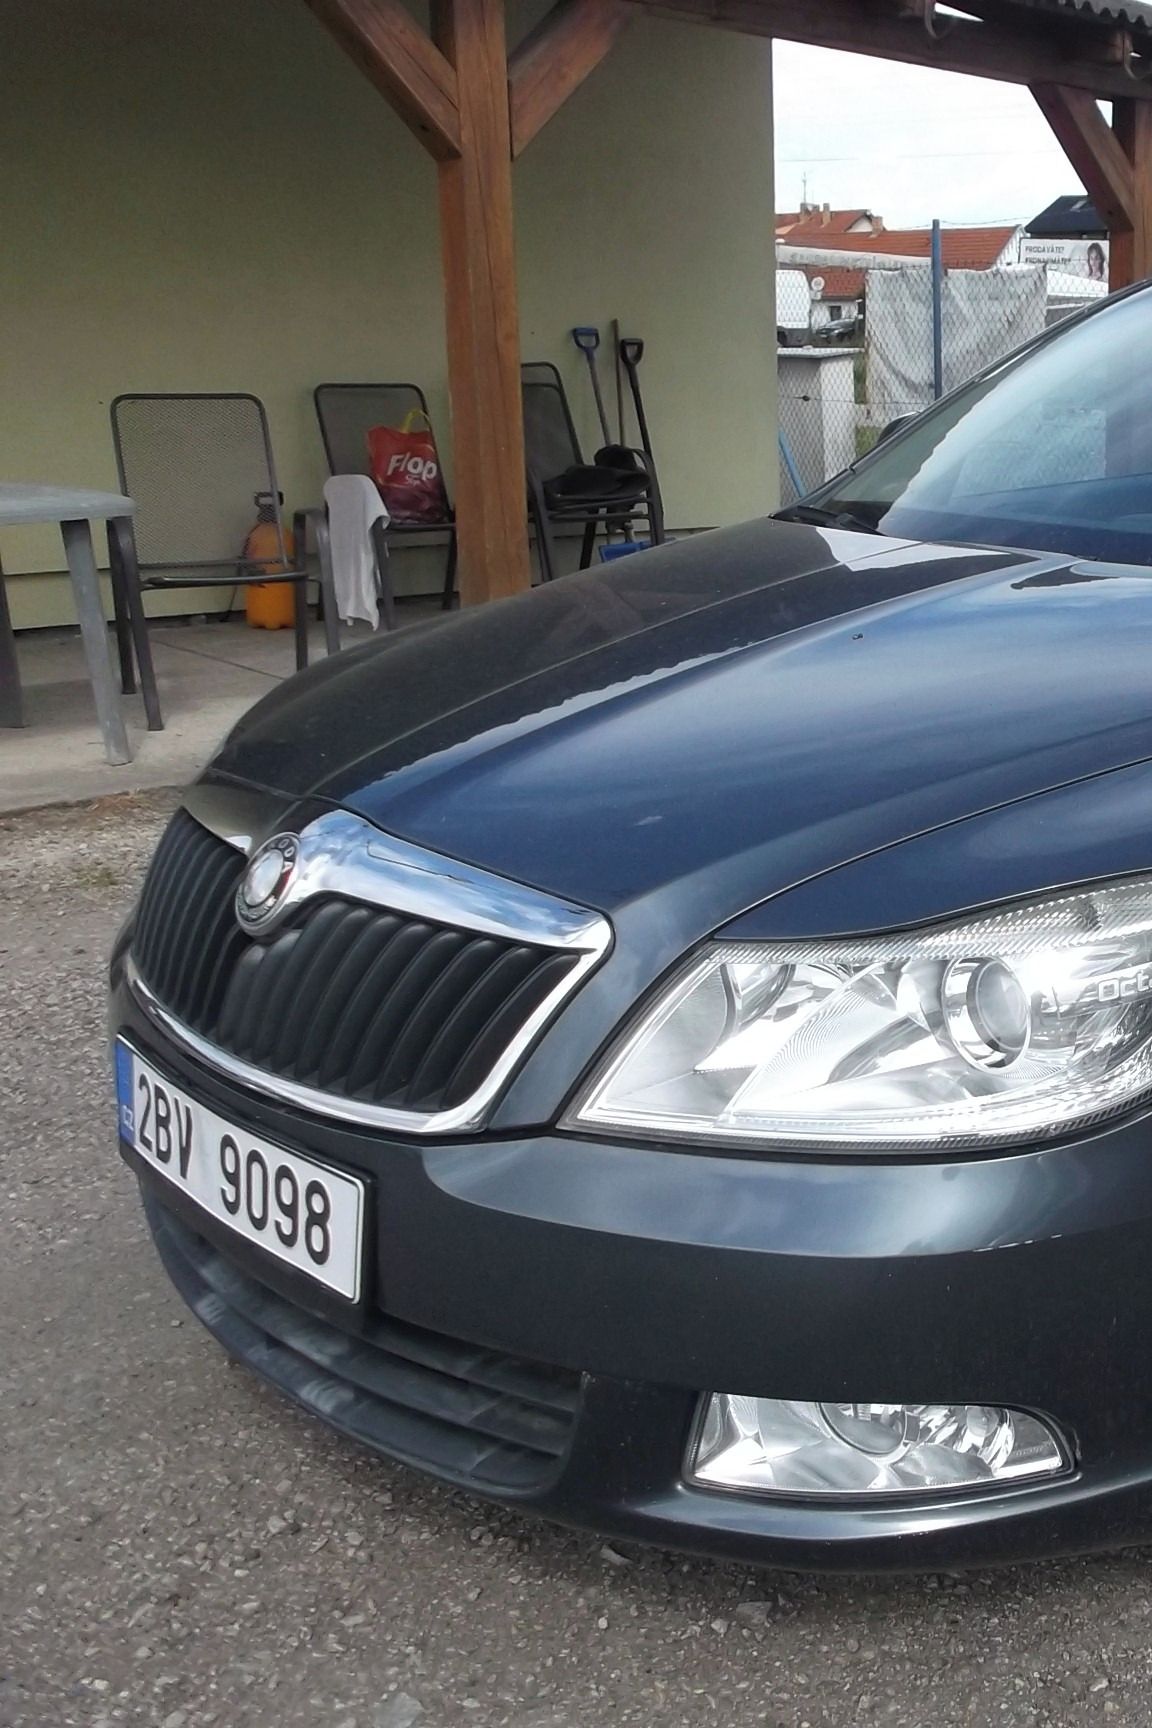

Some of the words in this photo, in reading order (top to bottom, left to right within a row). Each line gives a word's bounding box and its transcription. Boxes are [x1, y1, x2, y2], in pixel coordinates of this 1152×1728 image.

[387, 451, 437, 481] Flop
[138, 1073, 193, 1180] 2BV
[219, 1133, 331, 1265] 9098
